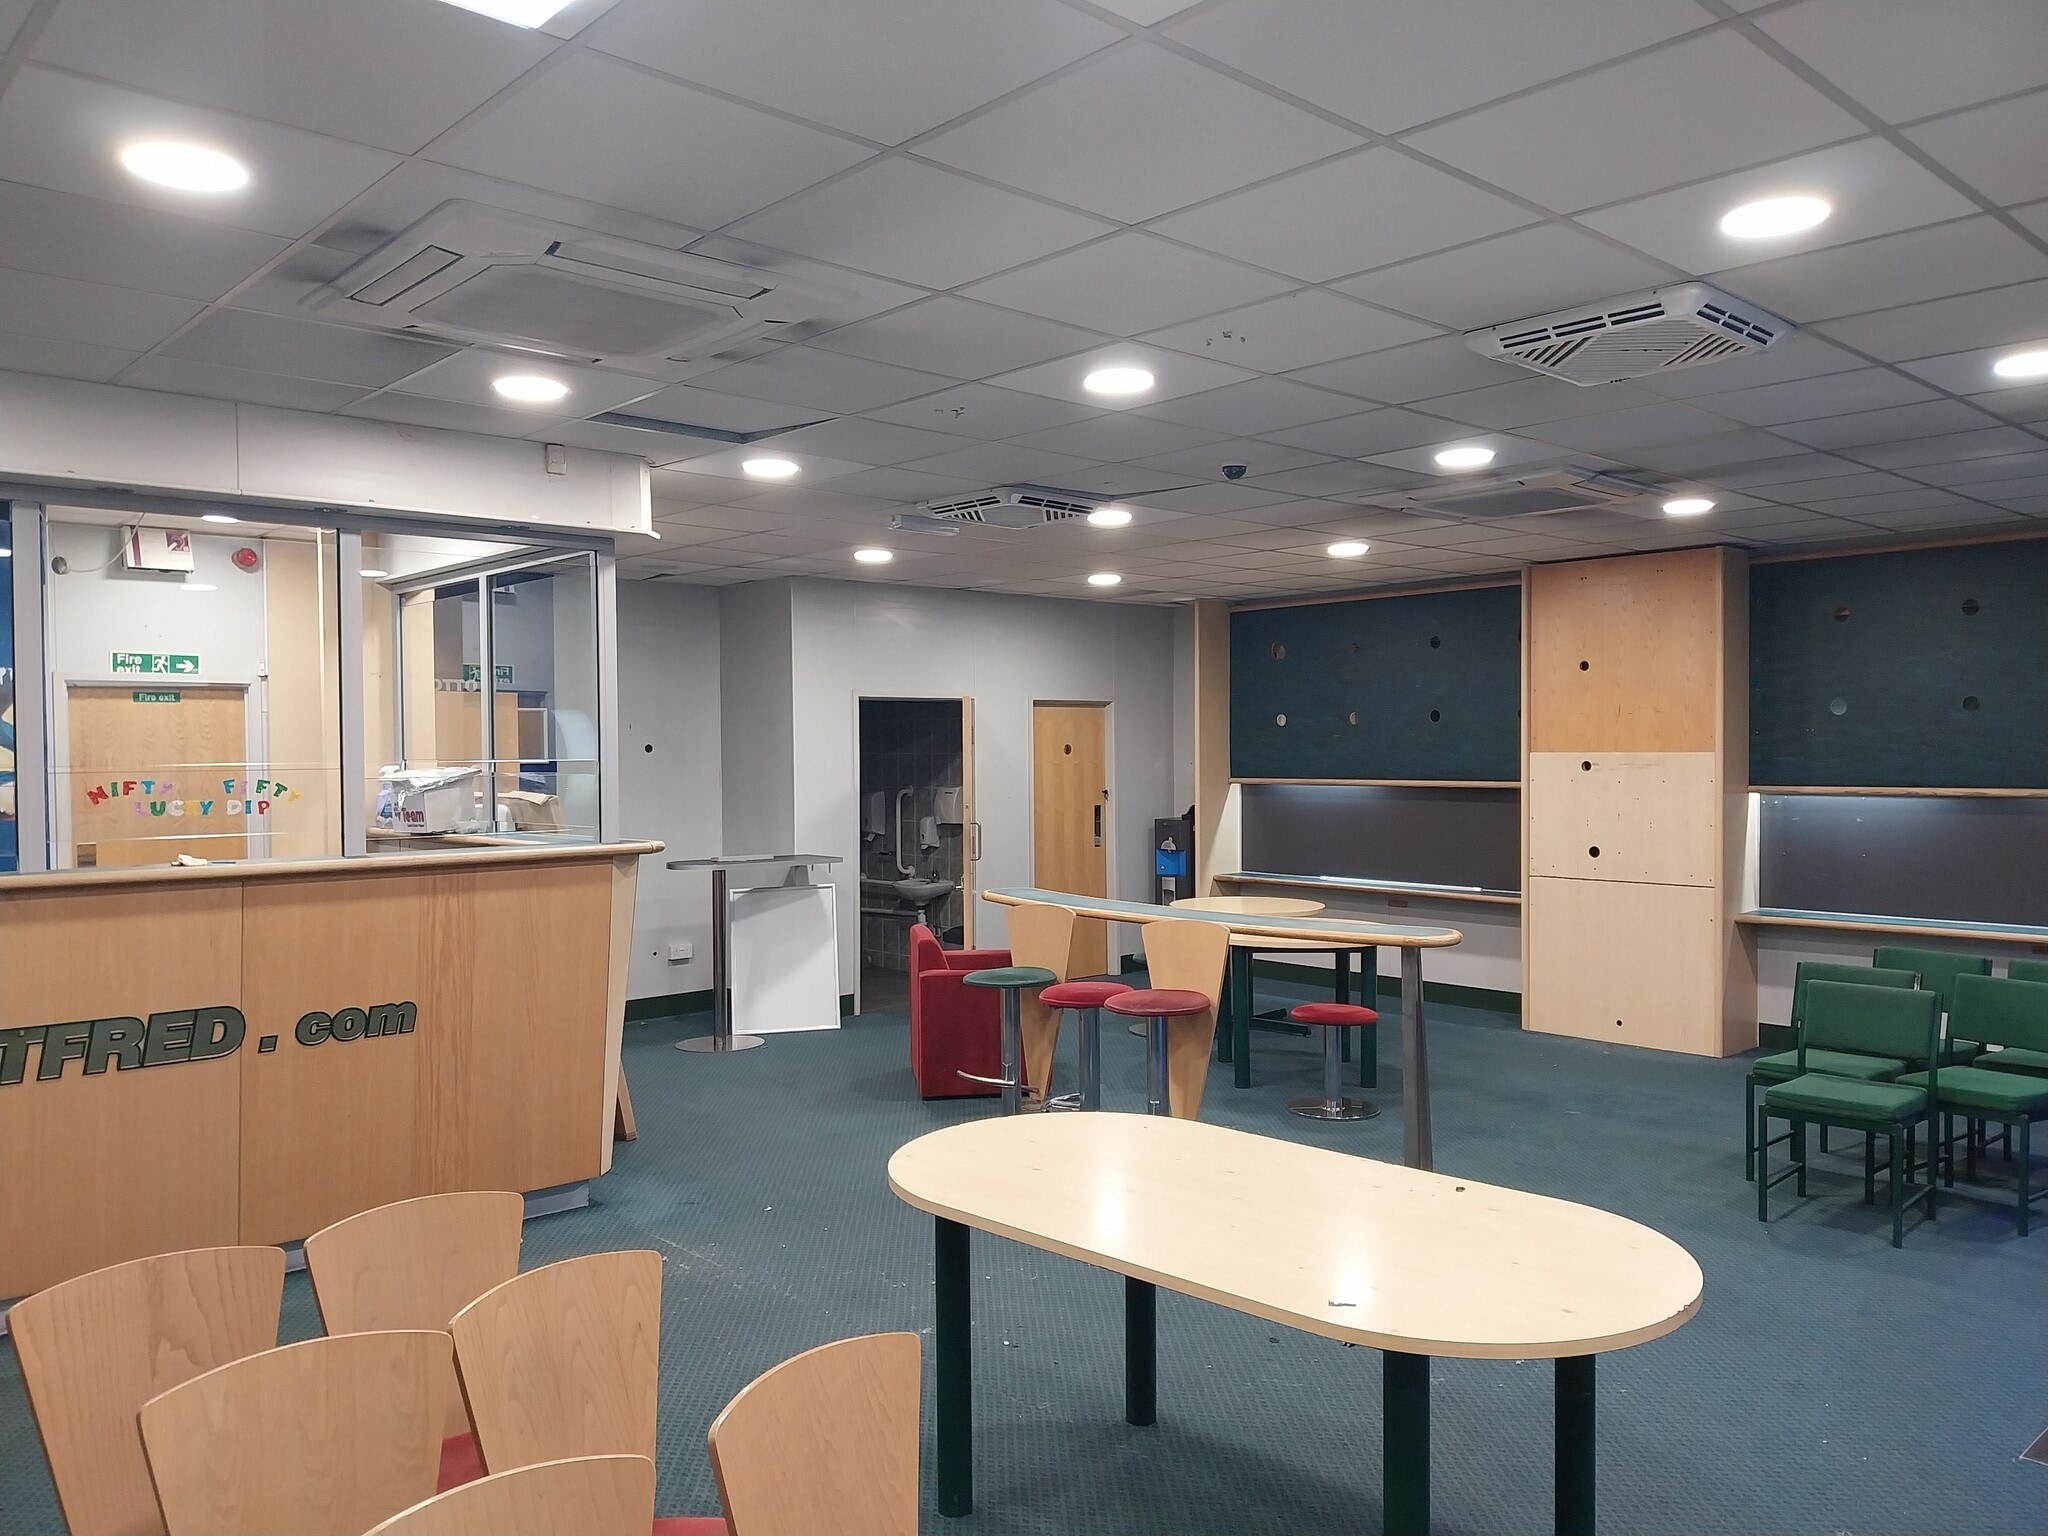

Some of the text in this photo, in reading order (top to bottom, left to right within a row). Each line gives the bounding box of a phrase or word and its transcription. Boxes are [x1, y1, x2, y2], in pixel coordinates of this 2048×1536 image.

[117, 653, 142, 665] Fire
[116, 665, 141, 674] exit
[139, 693, 176, 701] Fire exit
[86, 779, 300, 805] NIFTY FIFTY
[226, 799, 271, 816] DIP
